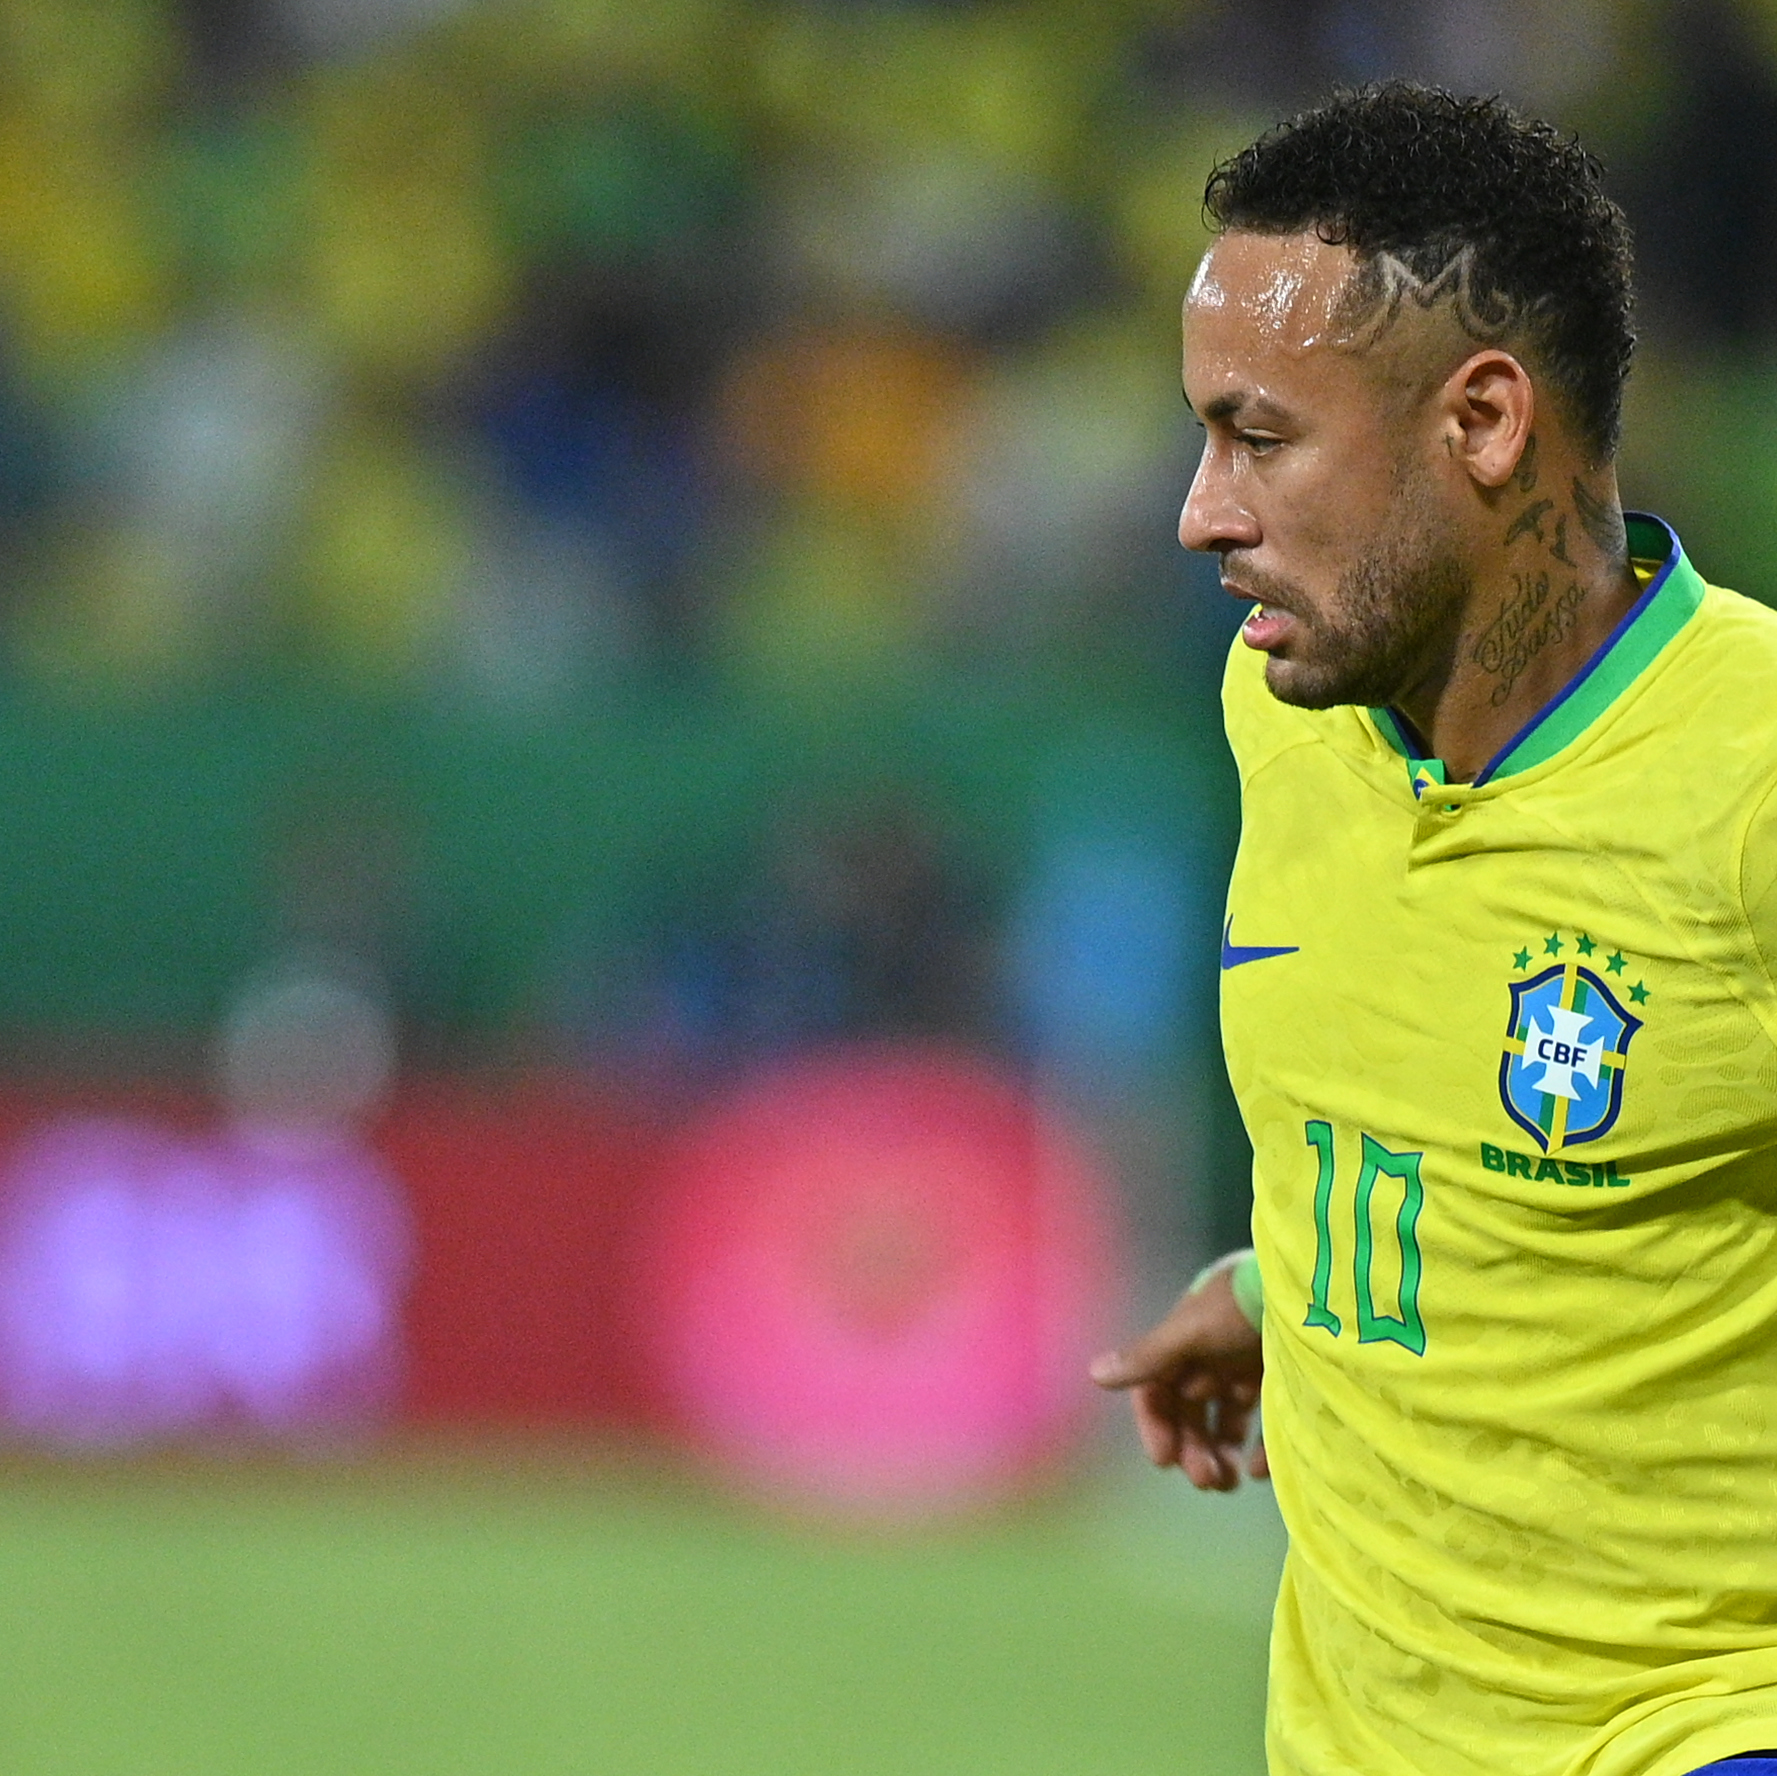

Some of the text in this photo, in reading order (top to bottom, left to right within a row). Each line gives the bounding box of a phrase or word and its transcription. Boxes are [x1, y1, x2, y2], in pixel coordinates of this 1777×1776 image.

[1537, 1038, 1588, 1068] CBF
[1480, 1142, 1631, 1188] BRASIL
[1302, 1119, 1427, 1357] 10
